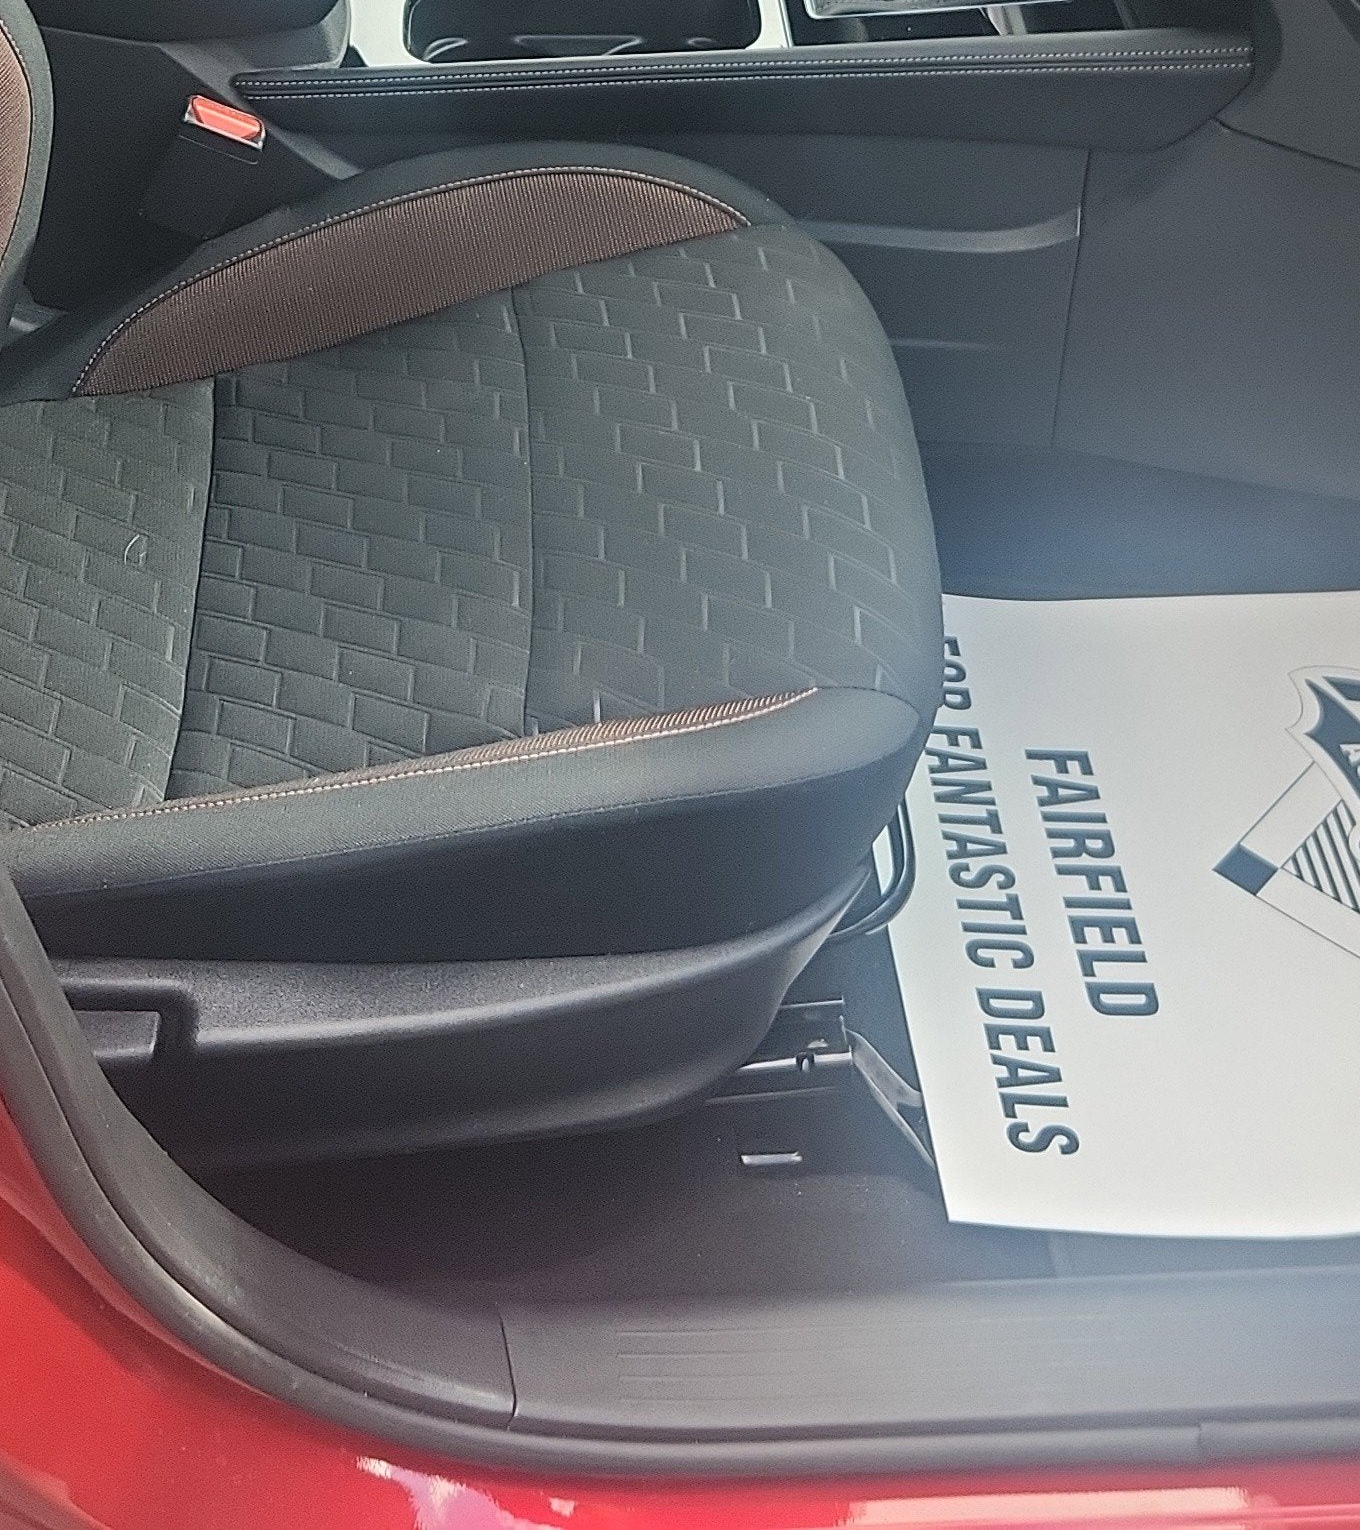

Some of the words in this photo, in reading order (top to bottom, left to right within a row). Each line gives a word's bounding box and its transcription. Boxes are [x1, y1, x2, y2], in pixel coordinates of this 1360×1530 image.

[925, 724, 1035, 970] FANTASTIC
[1024, 747, 1160, 1017] FAIRFIELD
[975, 987, 1080, 1156] DEALS
